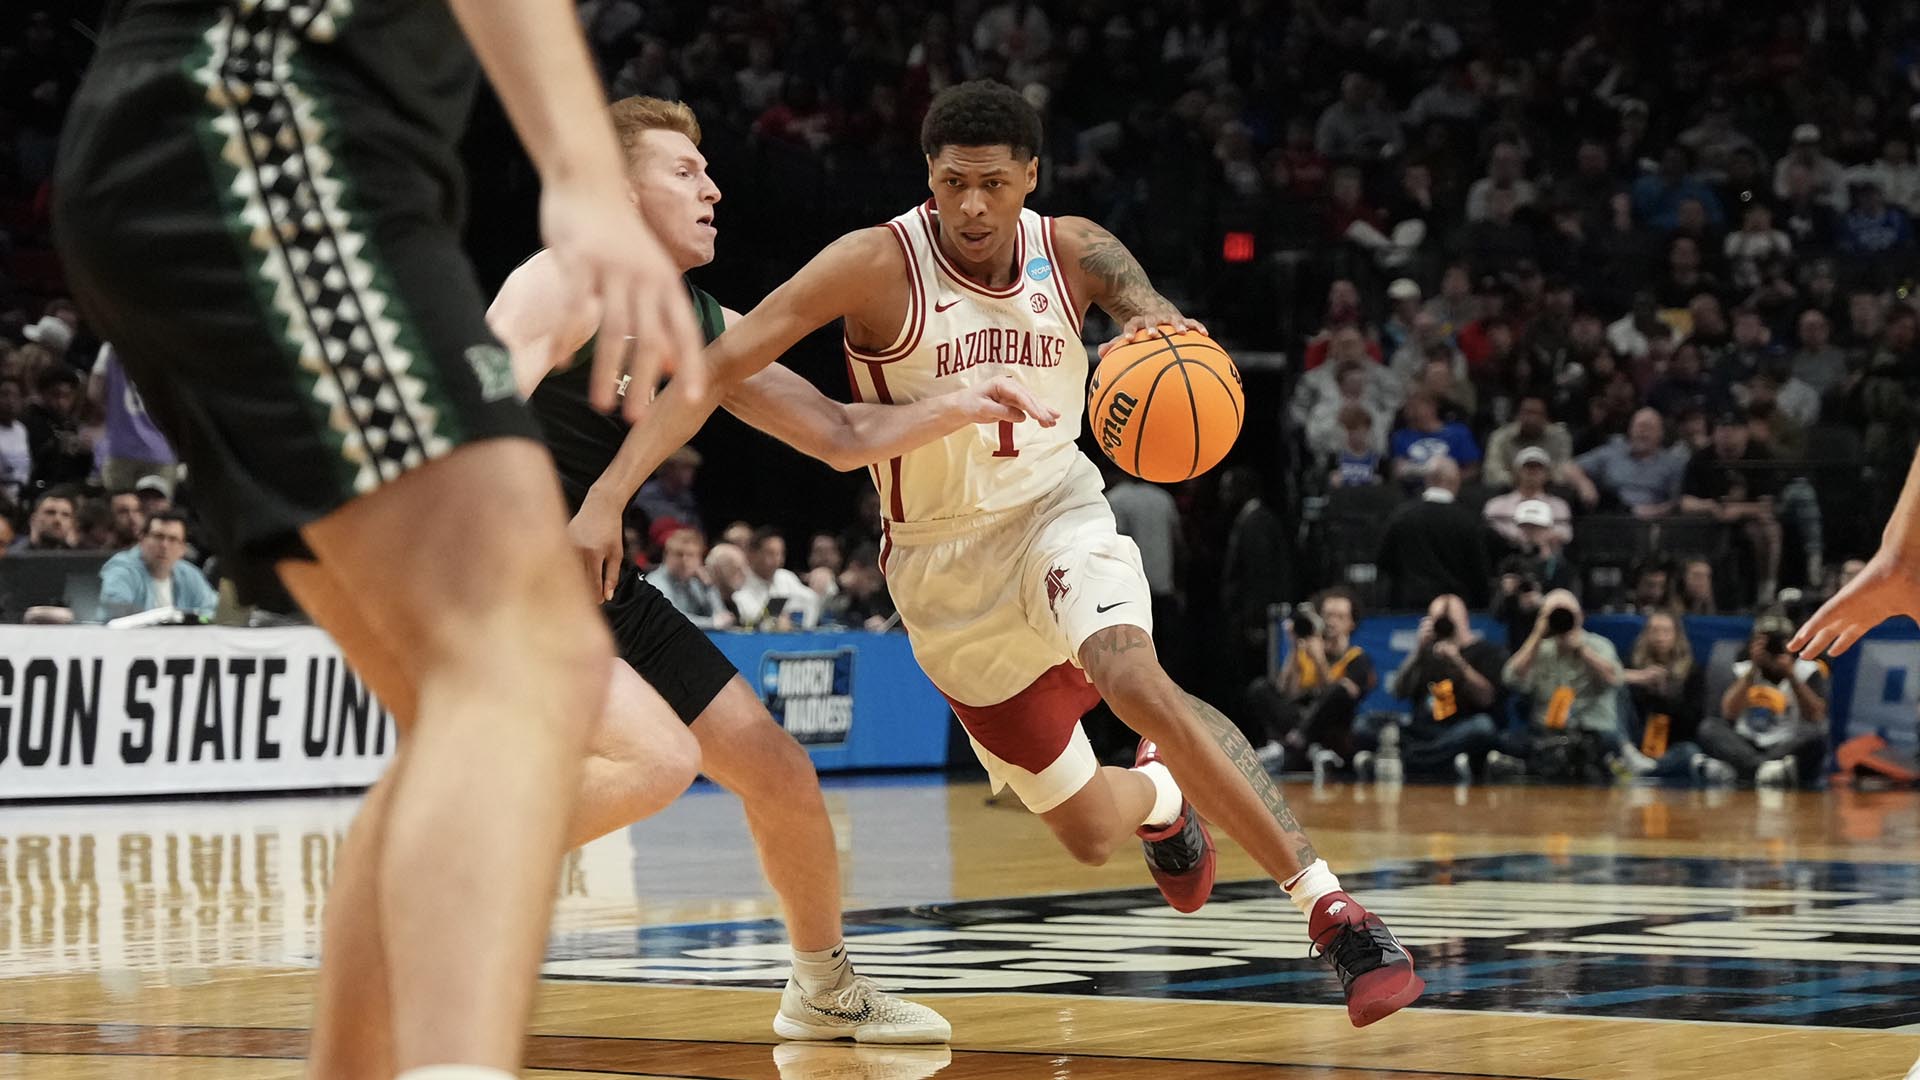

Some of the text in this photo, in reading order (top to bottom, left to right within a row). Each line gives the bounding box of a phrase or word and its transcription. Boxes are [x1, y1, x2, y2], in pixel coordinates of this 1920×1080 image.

[936, 328, 1065, 378] RAZORBACKS
[1103, 391, 1139, 462] Wilso
[778, 659, 834, 697] MARCH
[120, 658, 287, 764] STATE
[784, 695, 853, 734] MADNESS
